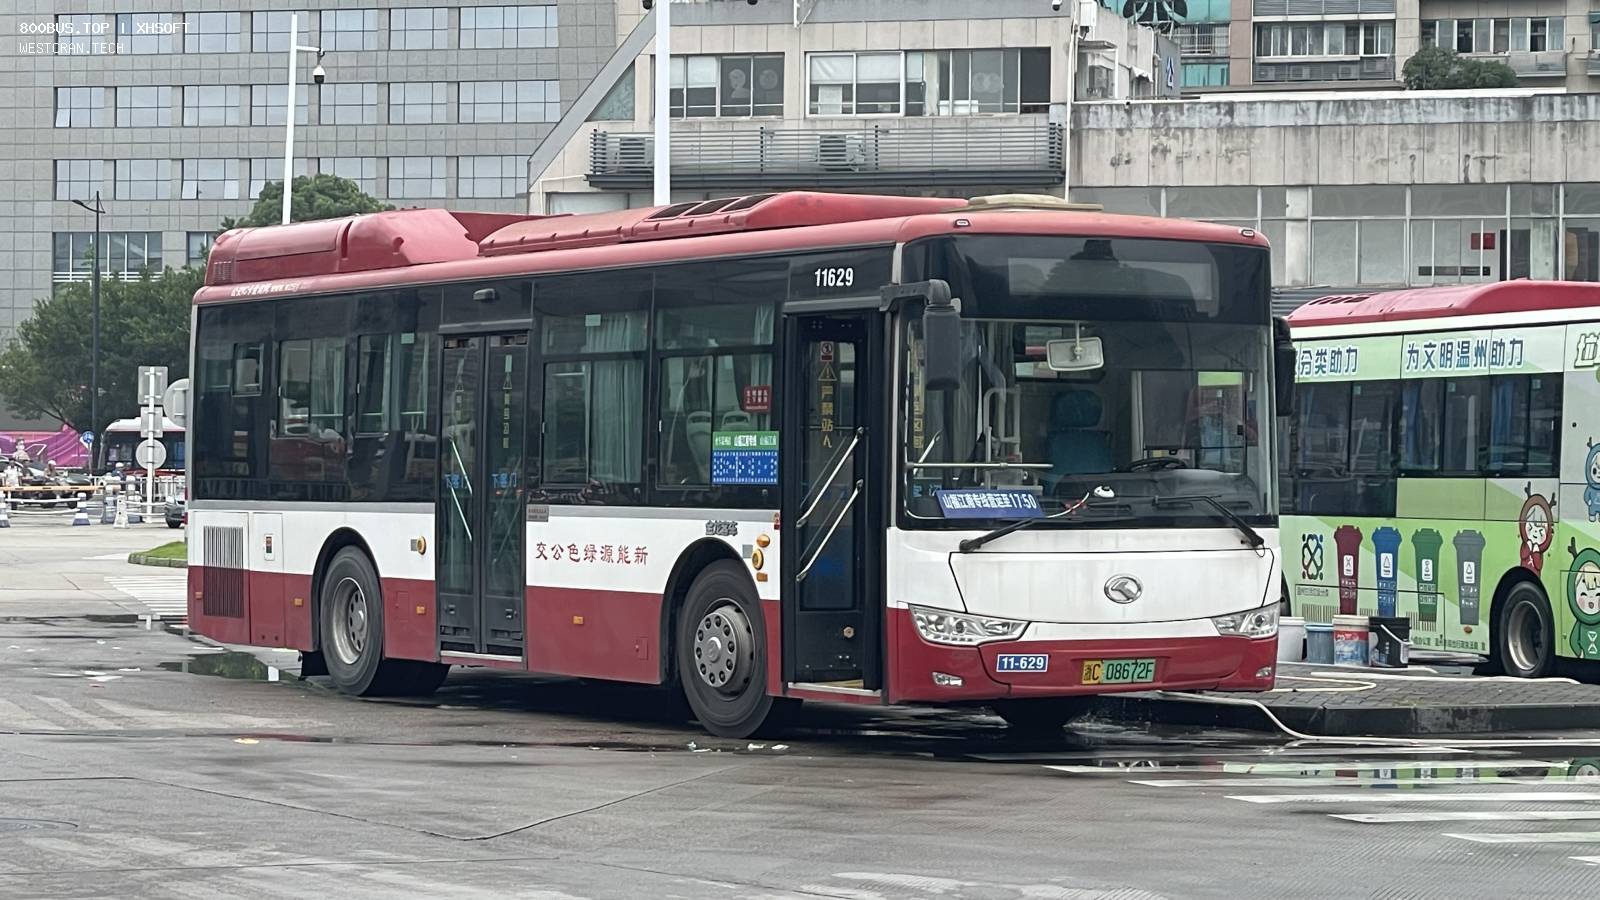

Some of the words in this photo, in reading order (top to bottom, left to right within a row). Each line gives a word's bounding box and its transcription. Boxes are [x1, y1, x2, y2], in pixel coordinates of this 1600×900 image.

[814, 267, 854, 287] 11629
[1294, 347, 1358, 376] 分类助力
[1406, 338, 1523, 370] 为文明温州助力
[1573, 332, 1600, 369] 垃
[1001, 657, 1044, 670] 11-629
